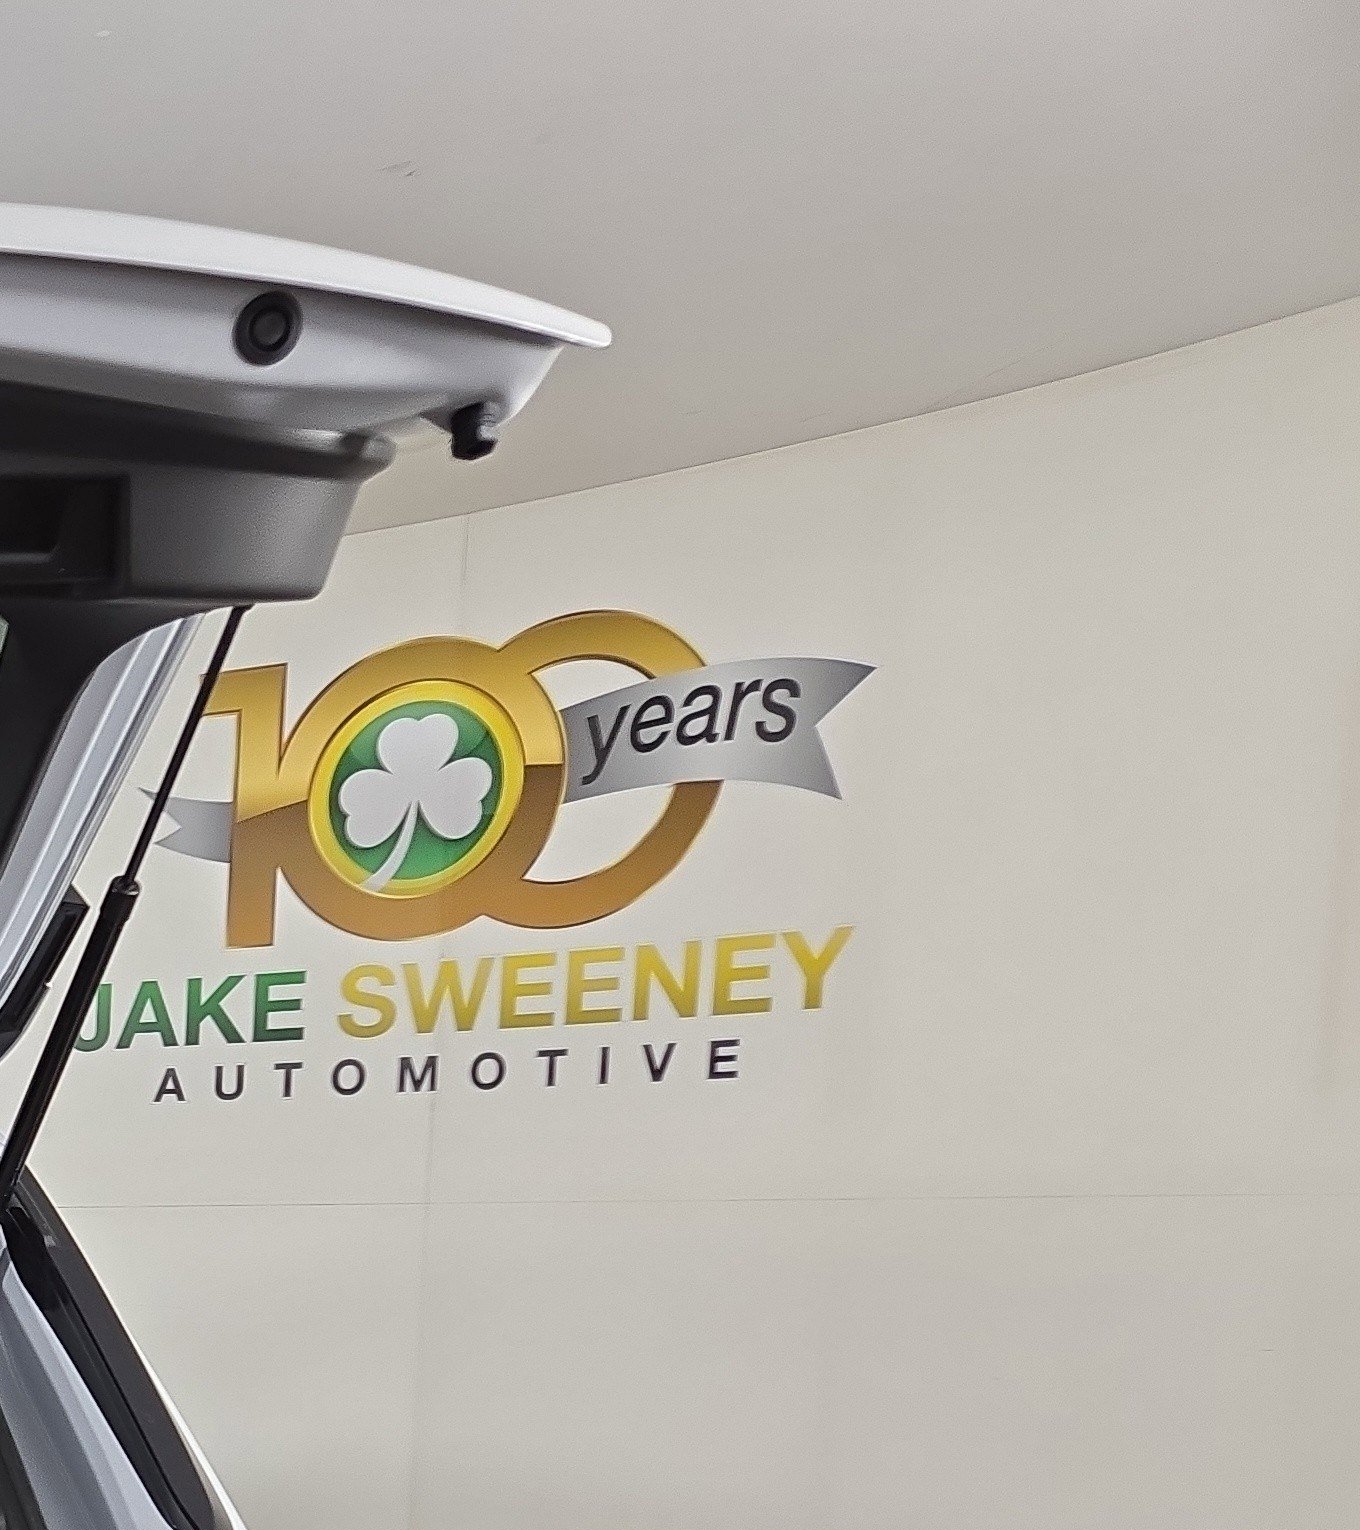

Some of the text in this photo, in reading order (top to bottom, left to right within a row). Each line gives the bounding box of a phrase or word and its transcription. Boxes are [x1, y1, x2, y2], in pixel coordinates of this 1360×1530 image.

[198, 609, 803, 948] 100 years
[73, 926, 853, 1052] JAKE SWEENEY
[153, 1040, 741, 1103] AUTOMOTIVE
